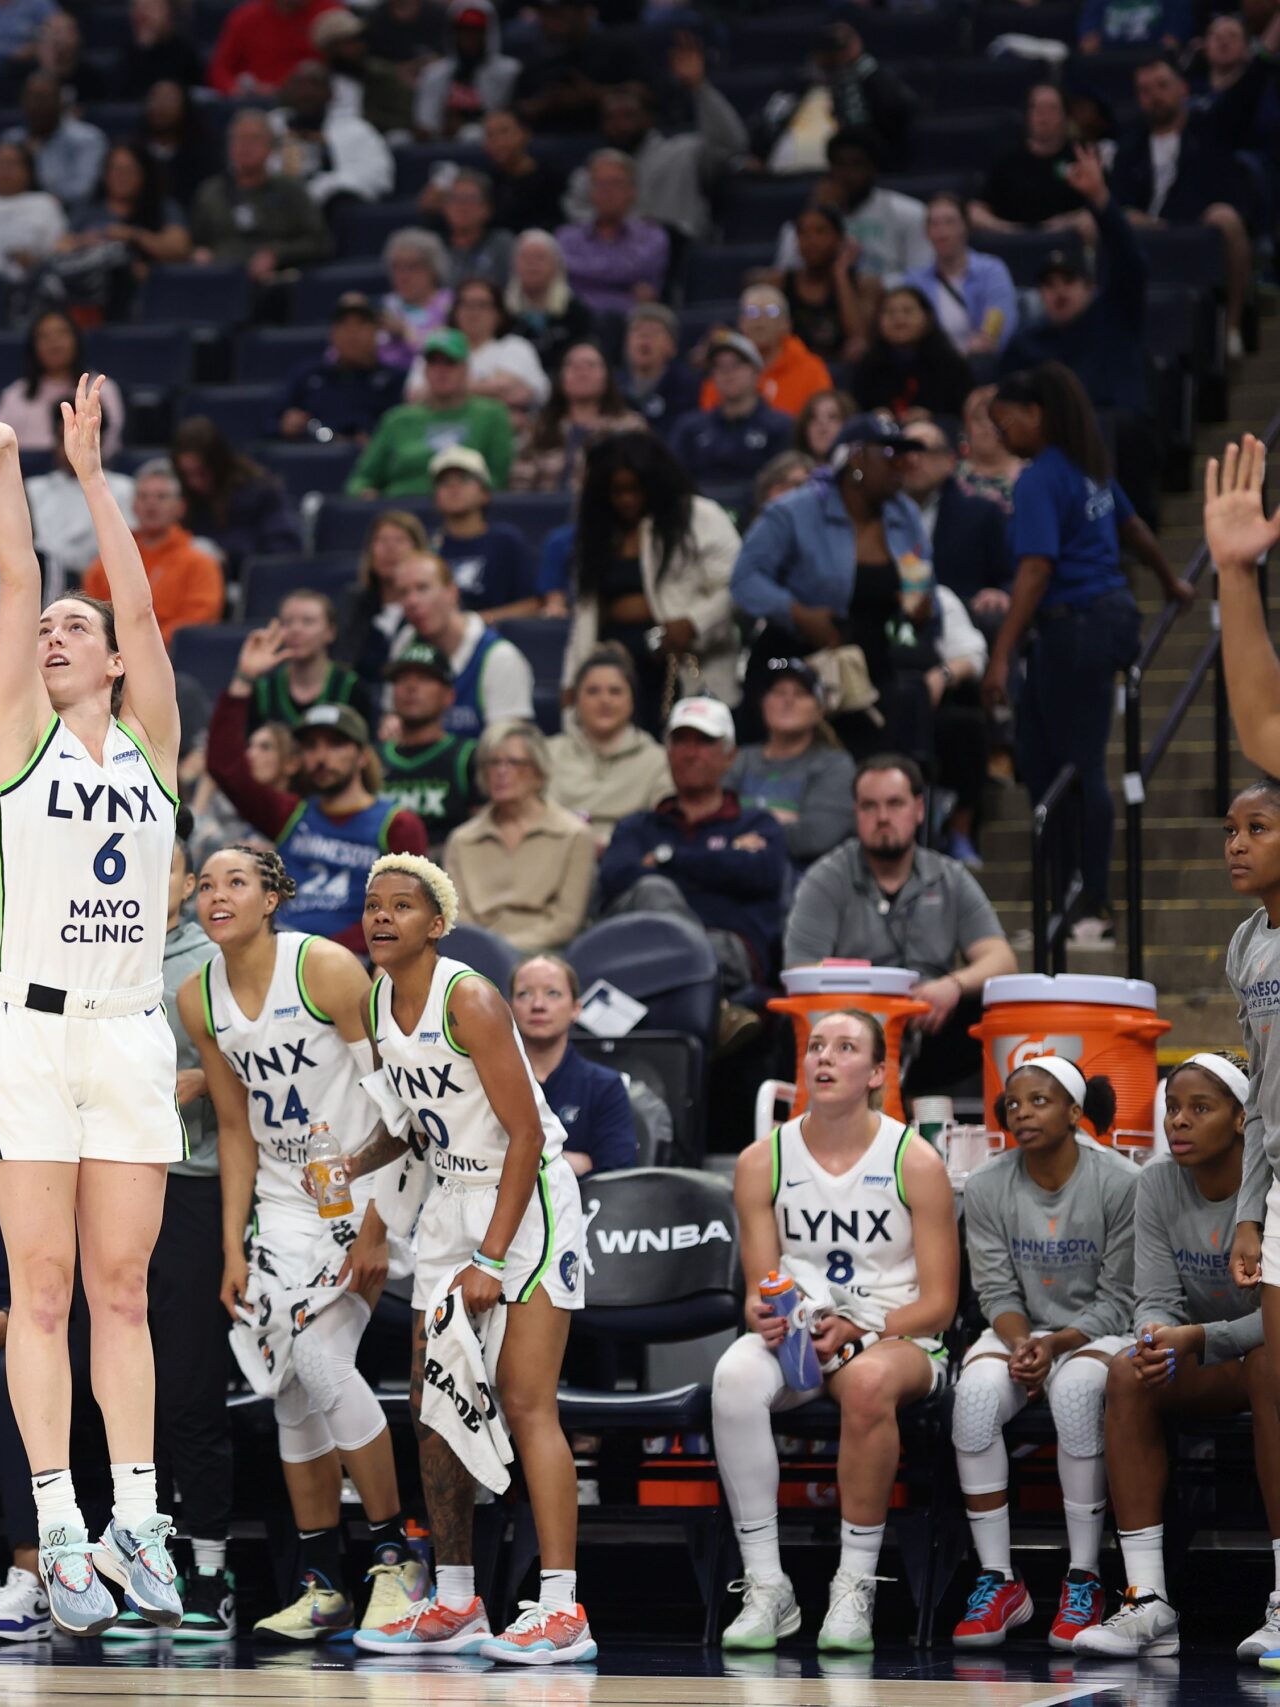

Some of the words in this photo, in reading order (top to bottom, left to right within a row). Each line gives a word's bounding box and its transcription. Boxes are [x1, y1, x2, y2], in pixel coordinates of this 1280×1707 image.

[47, 780, 158, 823] LYNX
[93, 832, 126, 885] 6
[299, 862, 351, 899] 24
[70, 900, 140, 919] MAYO
[61, 925, 144, 943] CLINIC
[387, 1063, 464, 1099] YNX
[252, 1084, 310, 1129] 24
[418, 1108, 449, 1149] 0
[276, 1145, 308, 1165] CLI
[434, 1151, 488, 1172] CLINIC
[596, 1220, 732, 1254] WNBA
[783, 1206, 892, 1243] LYNX
[826, 1249, 855, 1285] 8
[424, 1358, 483, 1434] RADE
